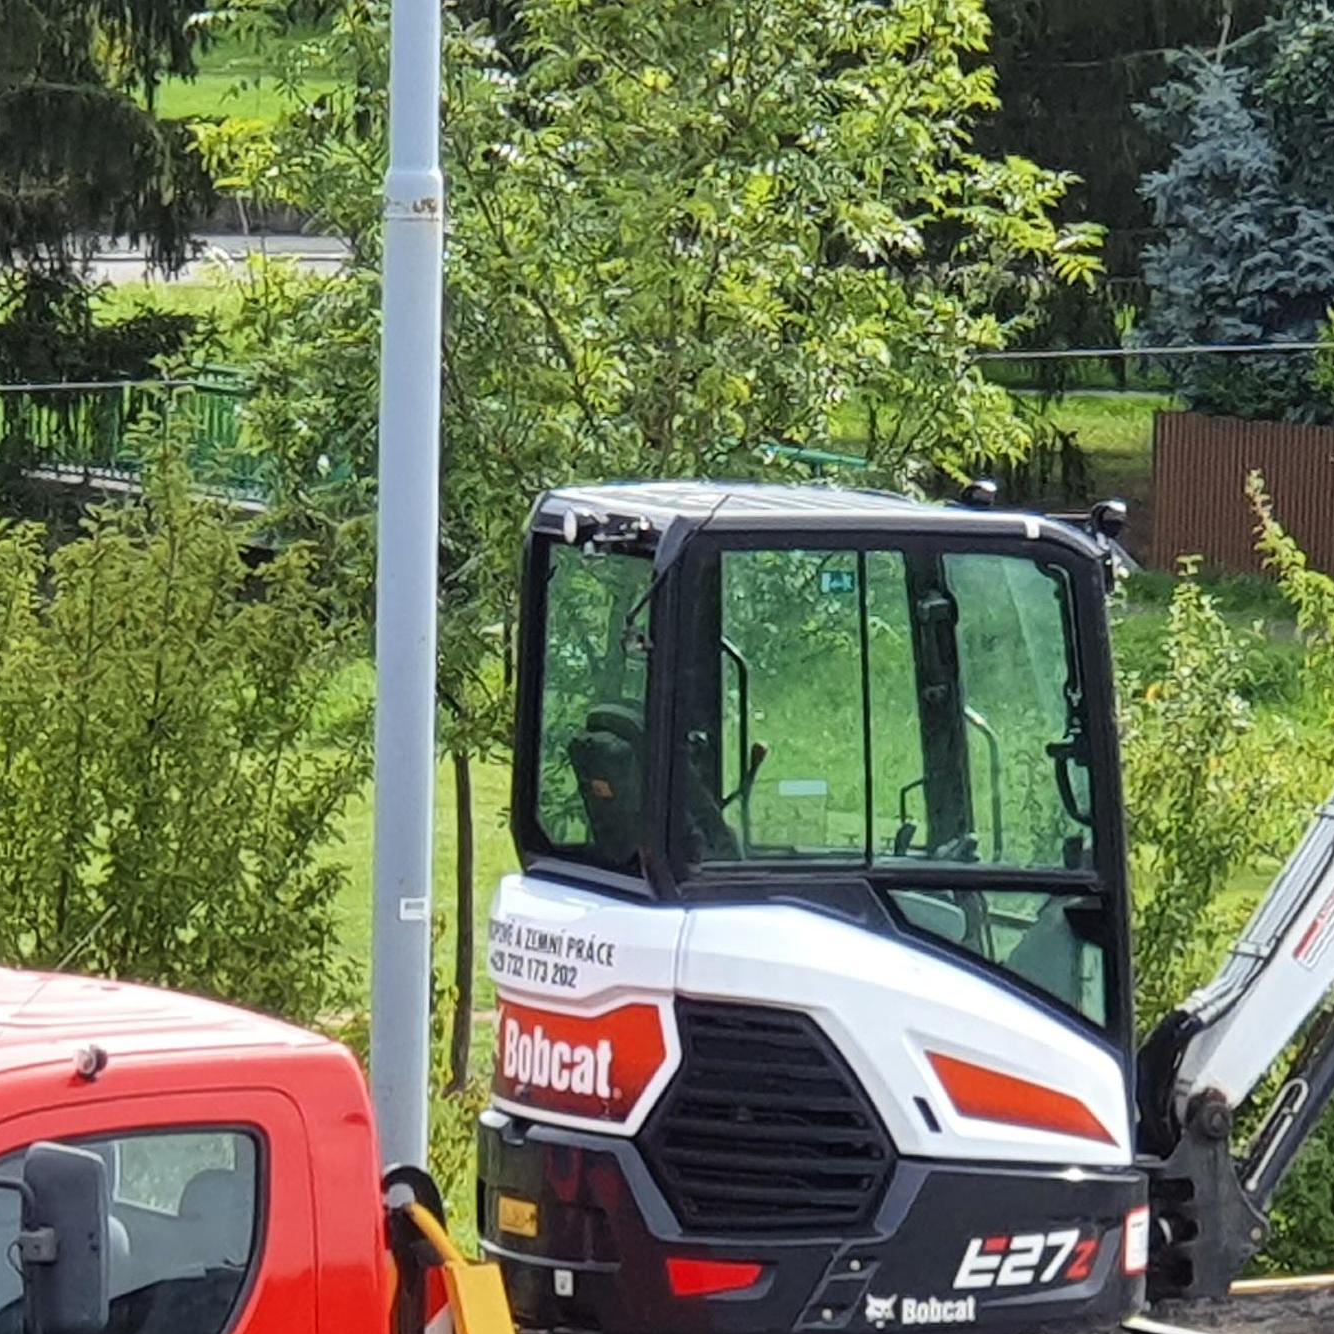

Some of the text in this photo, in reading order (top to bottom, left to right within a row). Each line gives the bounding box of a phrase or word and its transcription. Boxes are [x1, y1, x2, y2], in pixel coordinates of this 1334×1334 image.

[565, 933, 616, 968] PRÁCE
[527, 957, 548, 984] 173
[551, 962, 578, 989] 202
[503, 1017, 613, 1099] Bobcat
[901, 1295, 976, 1325] Bobcat
